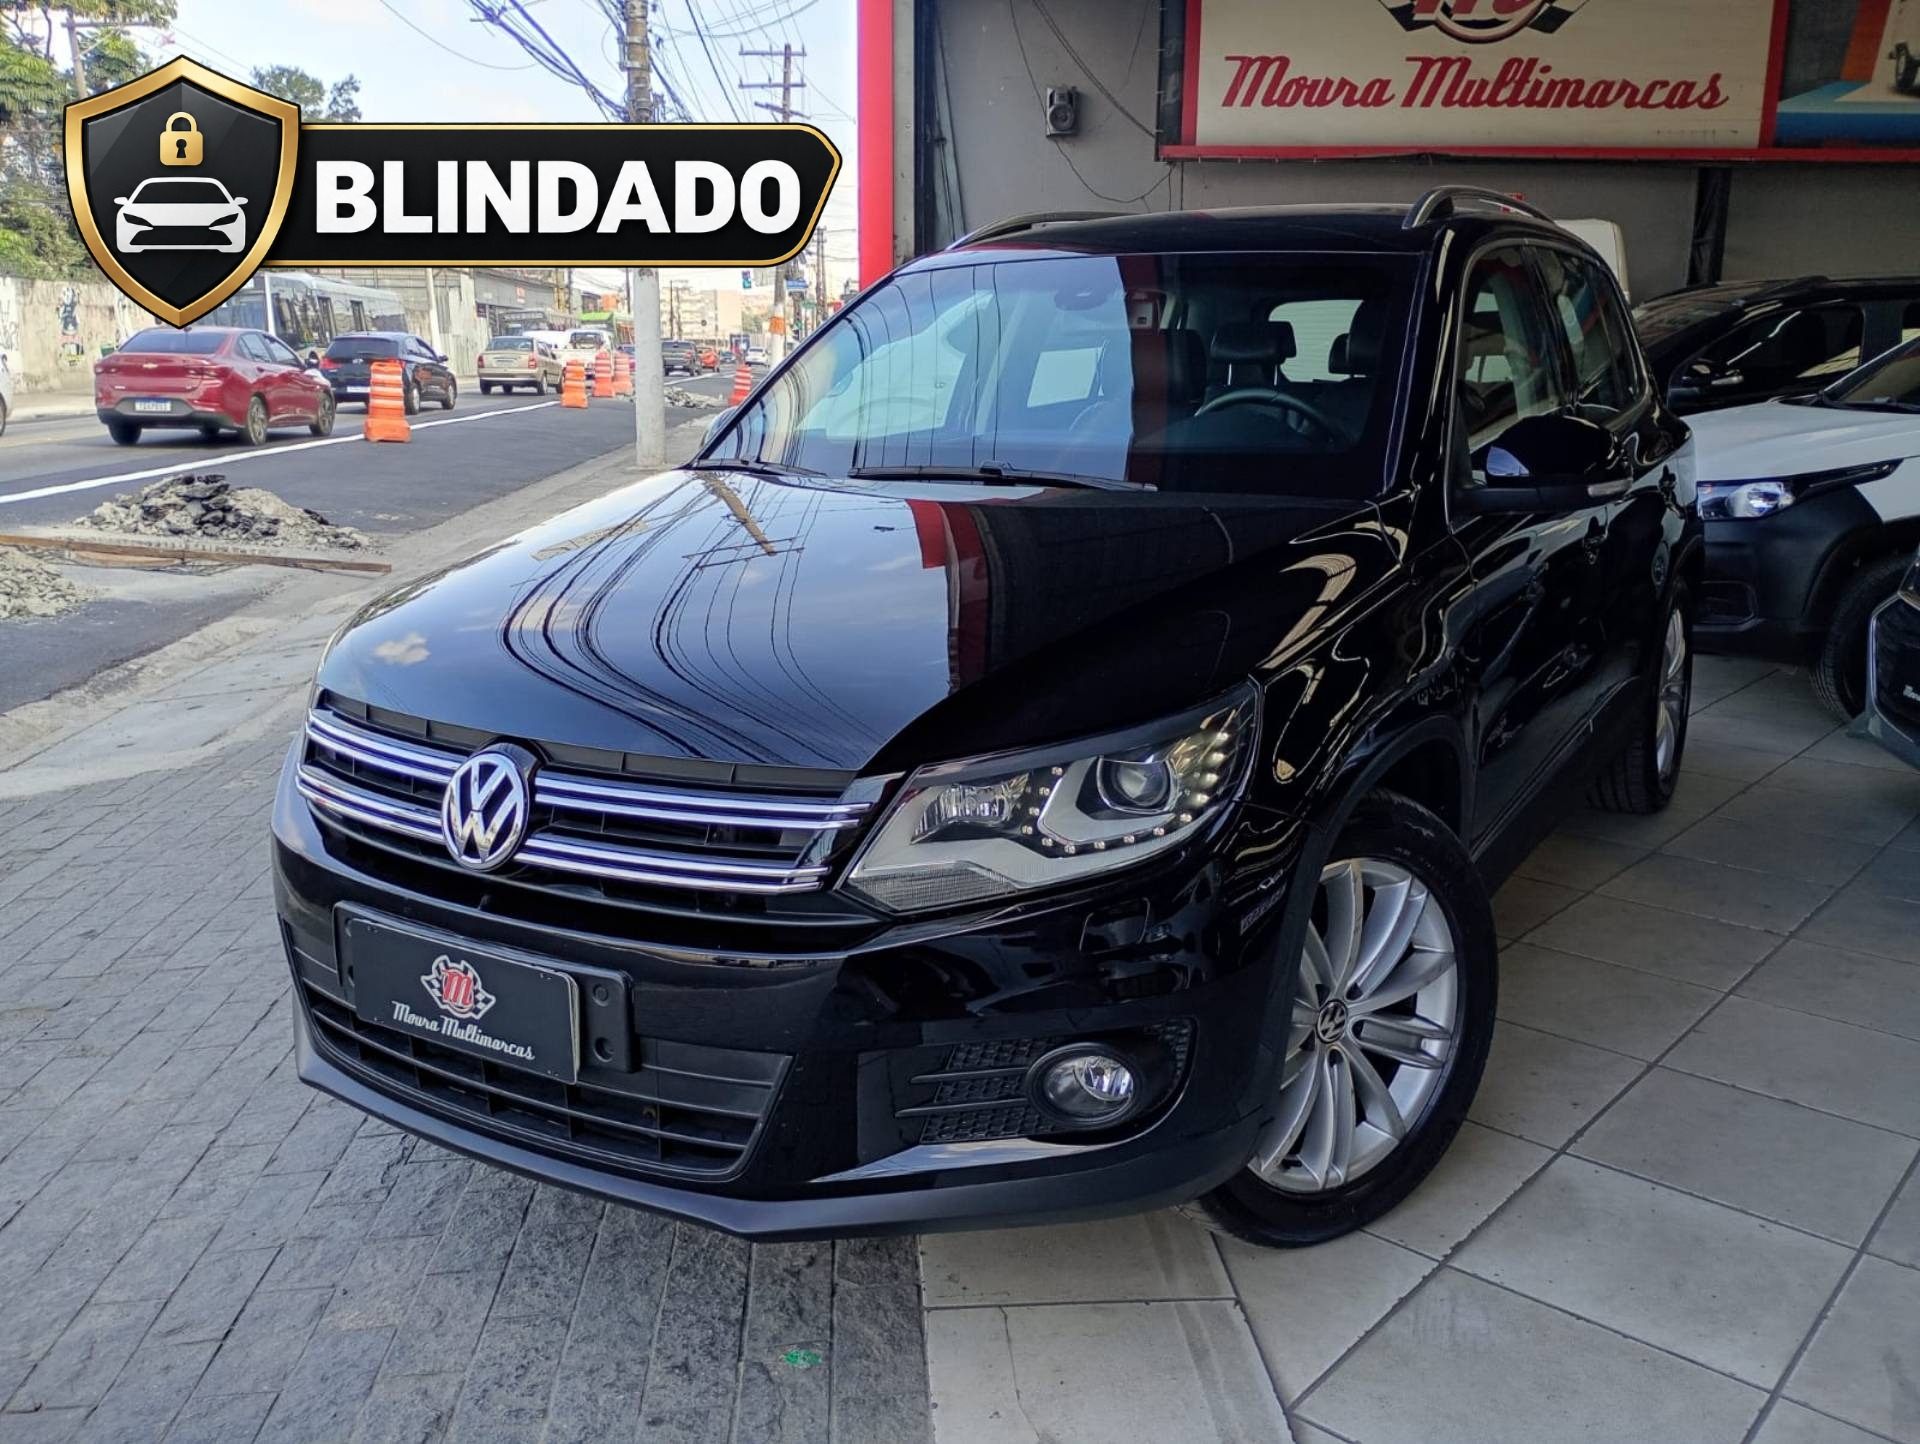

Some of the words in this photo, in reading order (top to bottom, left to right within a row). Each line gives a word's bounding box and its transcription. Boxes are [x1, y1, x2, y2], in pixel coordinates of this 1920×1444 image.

[1221, 55, 1395, 108] Moura
[1400, 55, 1730, 110] Multimarcas
[443, 752, 527, 870] VW
[391, 1000, 441, 1033] Moura
[440, 1015, 536, 1062] Multimarcas
